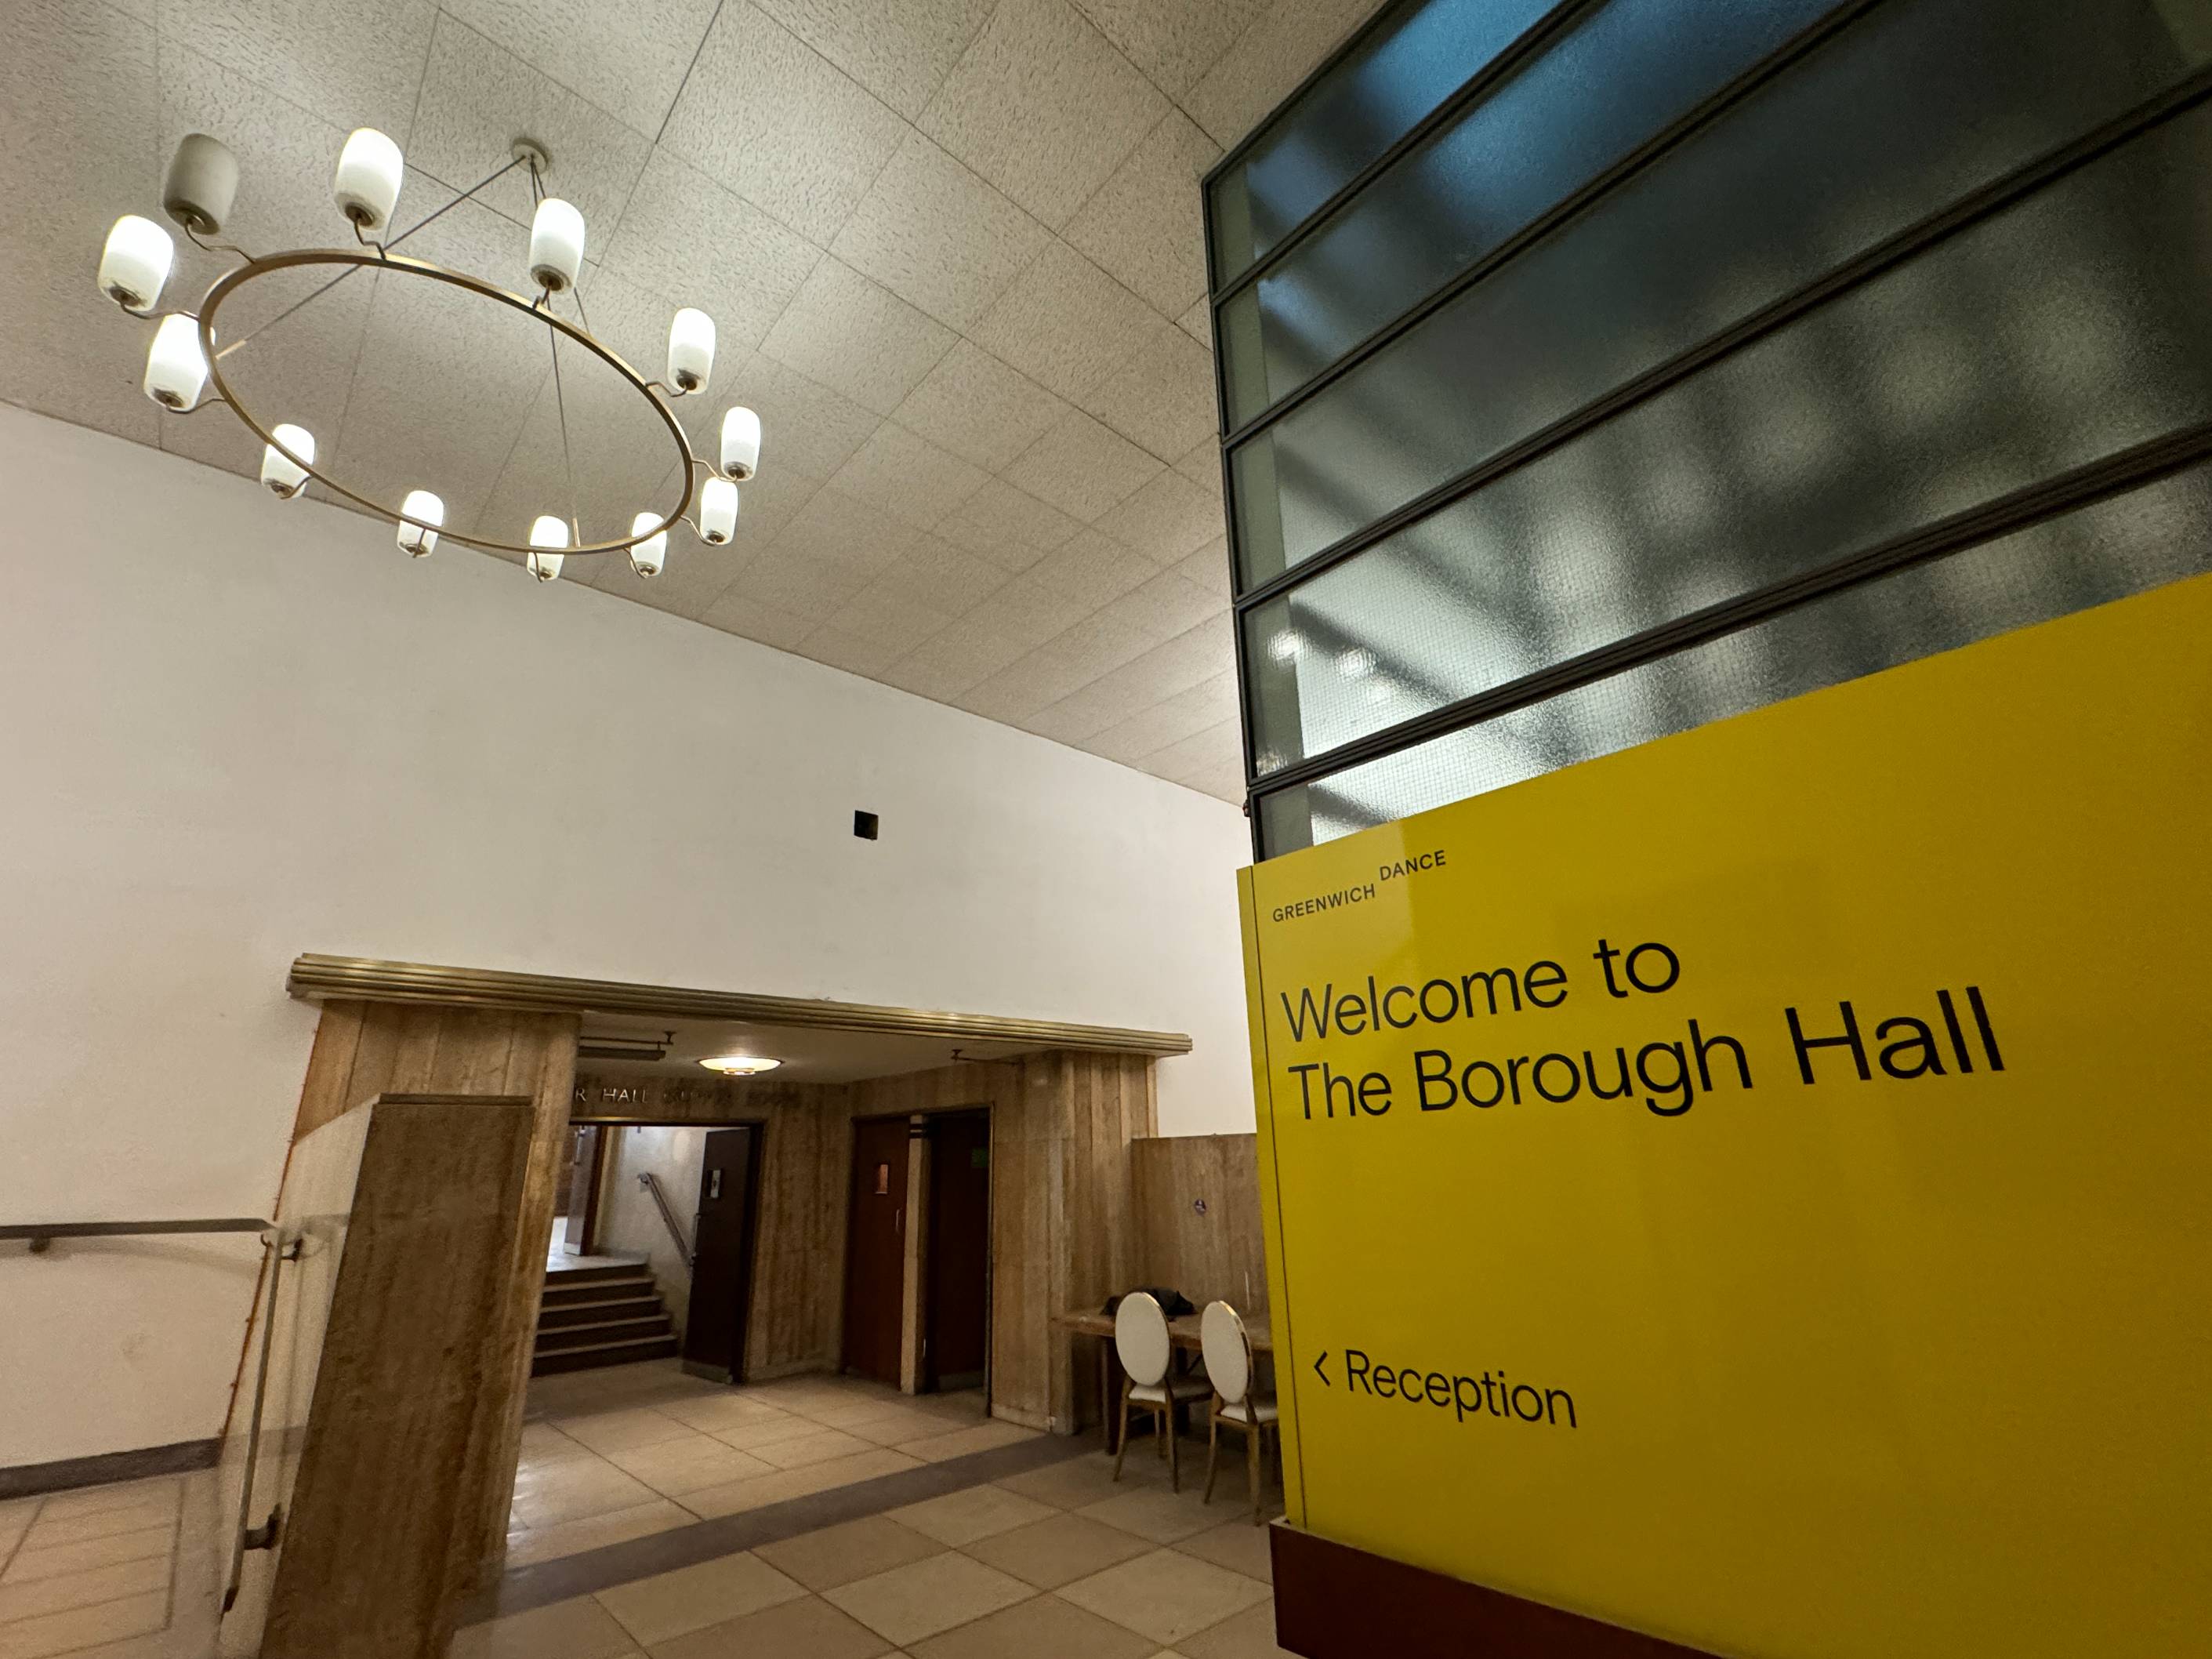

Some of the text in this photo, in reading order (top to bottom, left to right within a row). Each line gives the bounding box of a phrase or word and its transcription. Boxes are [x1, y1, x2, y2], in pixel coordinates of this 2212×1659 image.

[1272, 849, 1447, 923] GREENWICH DANCE
[1280, 938, 1681, 1043] Welcome to
[1288, 986, 2005, 1120] The Borough Hall
[602, 1087, 647, 1102] HALL
[1345, 1349, 1578, 1428] Reception
